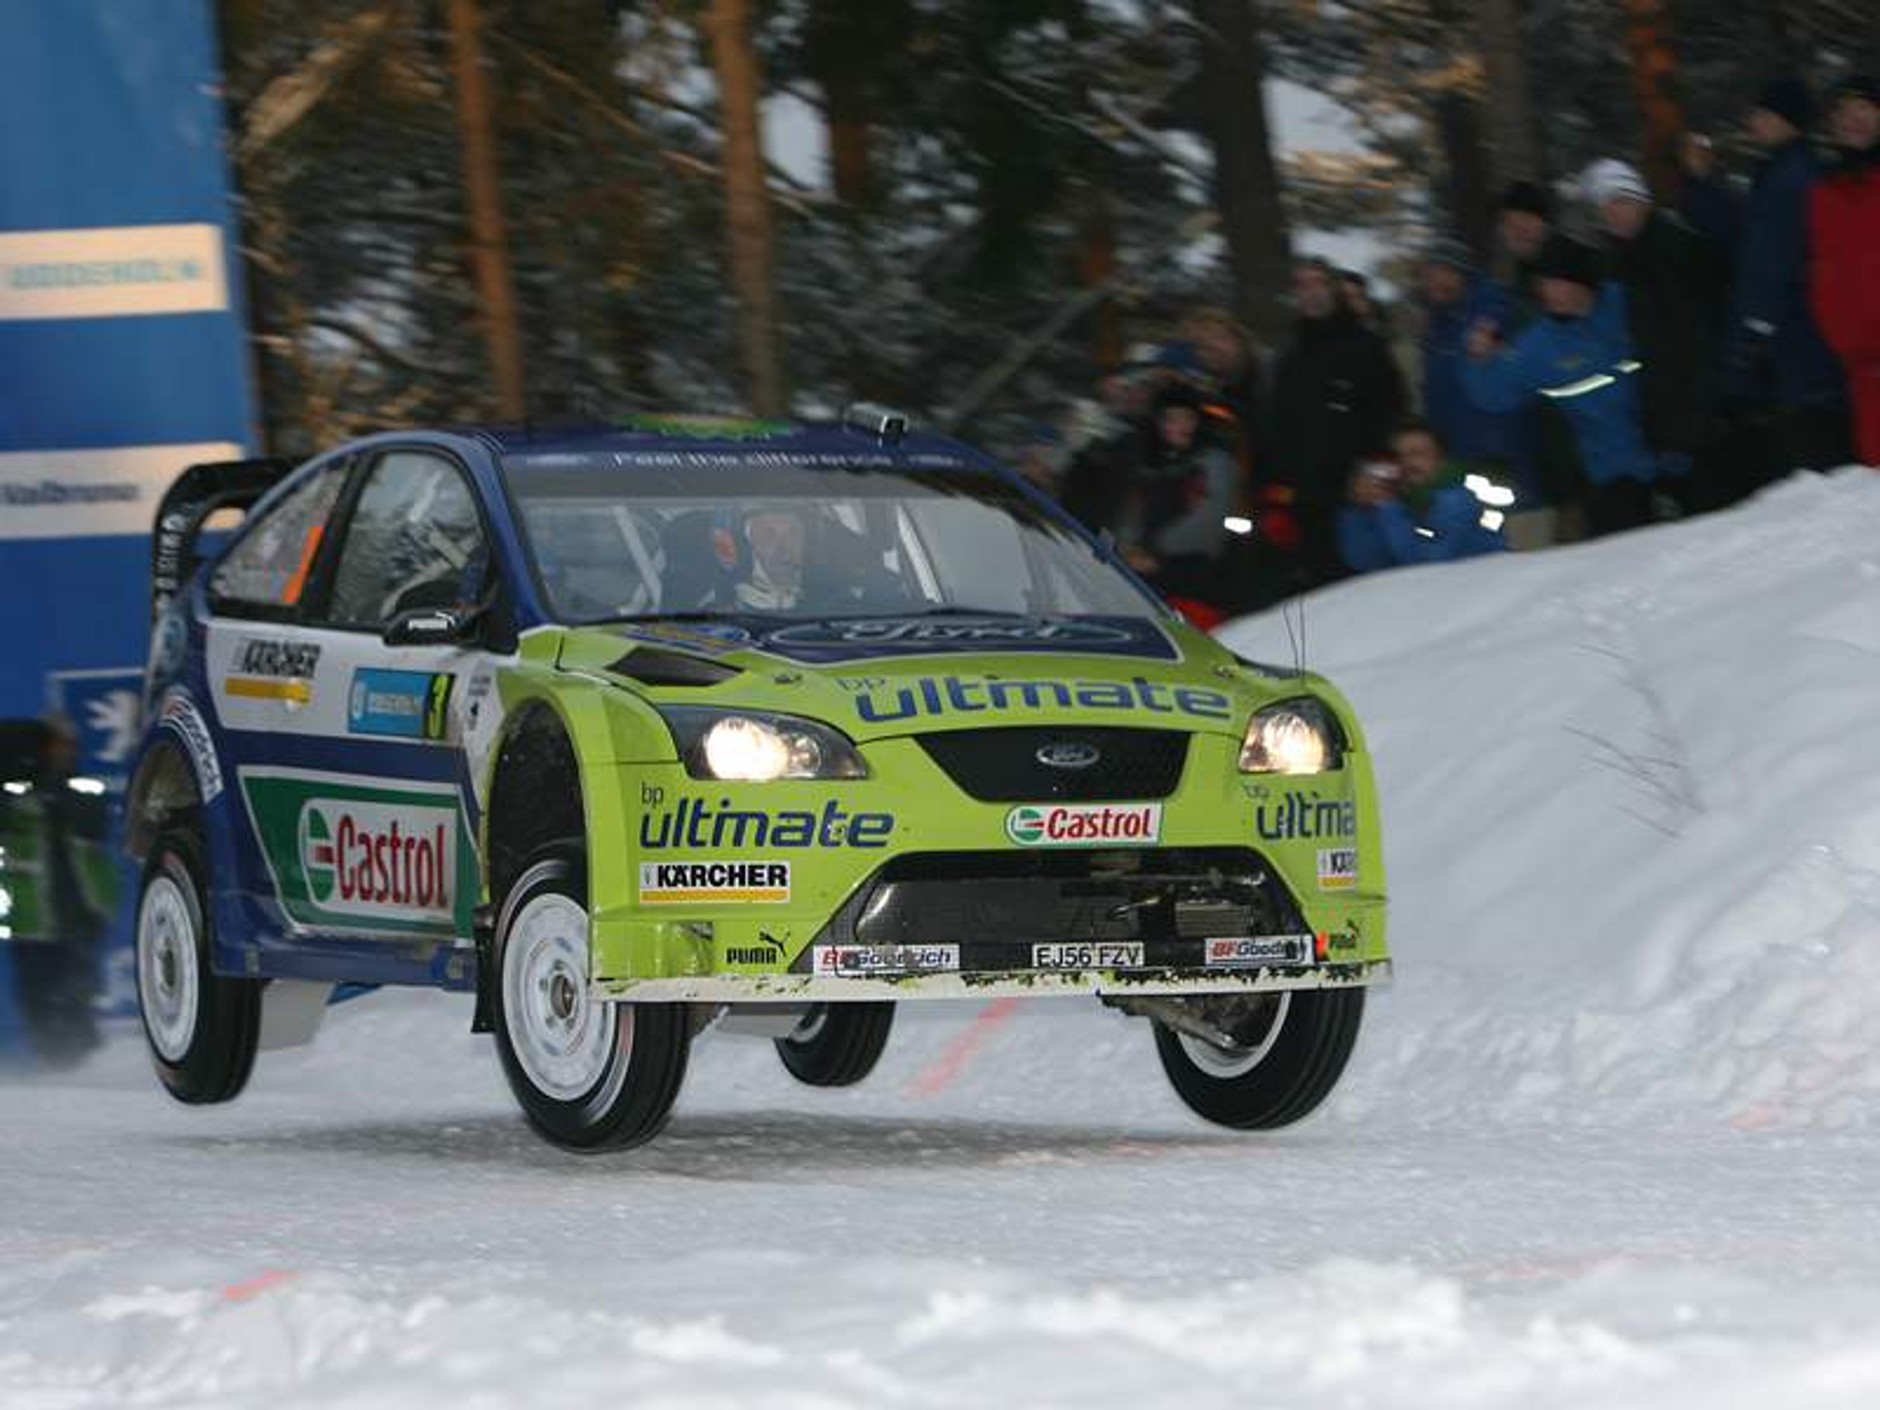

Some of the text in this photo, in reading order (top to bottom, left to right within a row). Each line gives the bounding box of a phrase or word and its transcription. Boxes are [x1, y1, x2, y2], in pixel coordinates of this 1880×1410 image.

[429, 674, 450, 738] 3
[856, 675, 1231, 723] ultimate
[641, 781, 665, 806] bp
[640, 796, 895, 849] ultimate
[1047, 807, 1152, 840] Castrol
[336, 813, 447, 908] Castrol
[656, 863, 789, 889] KÄRCHER
[726, 946, 779, 966] PUMA
[1036, 944, 1141, 967] EJ56 FZV
